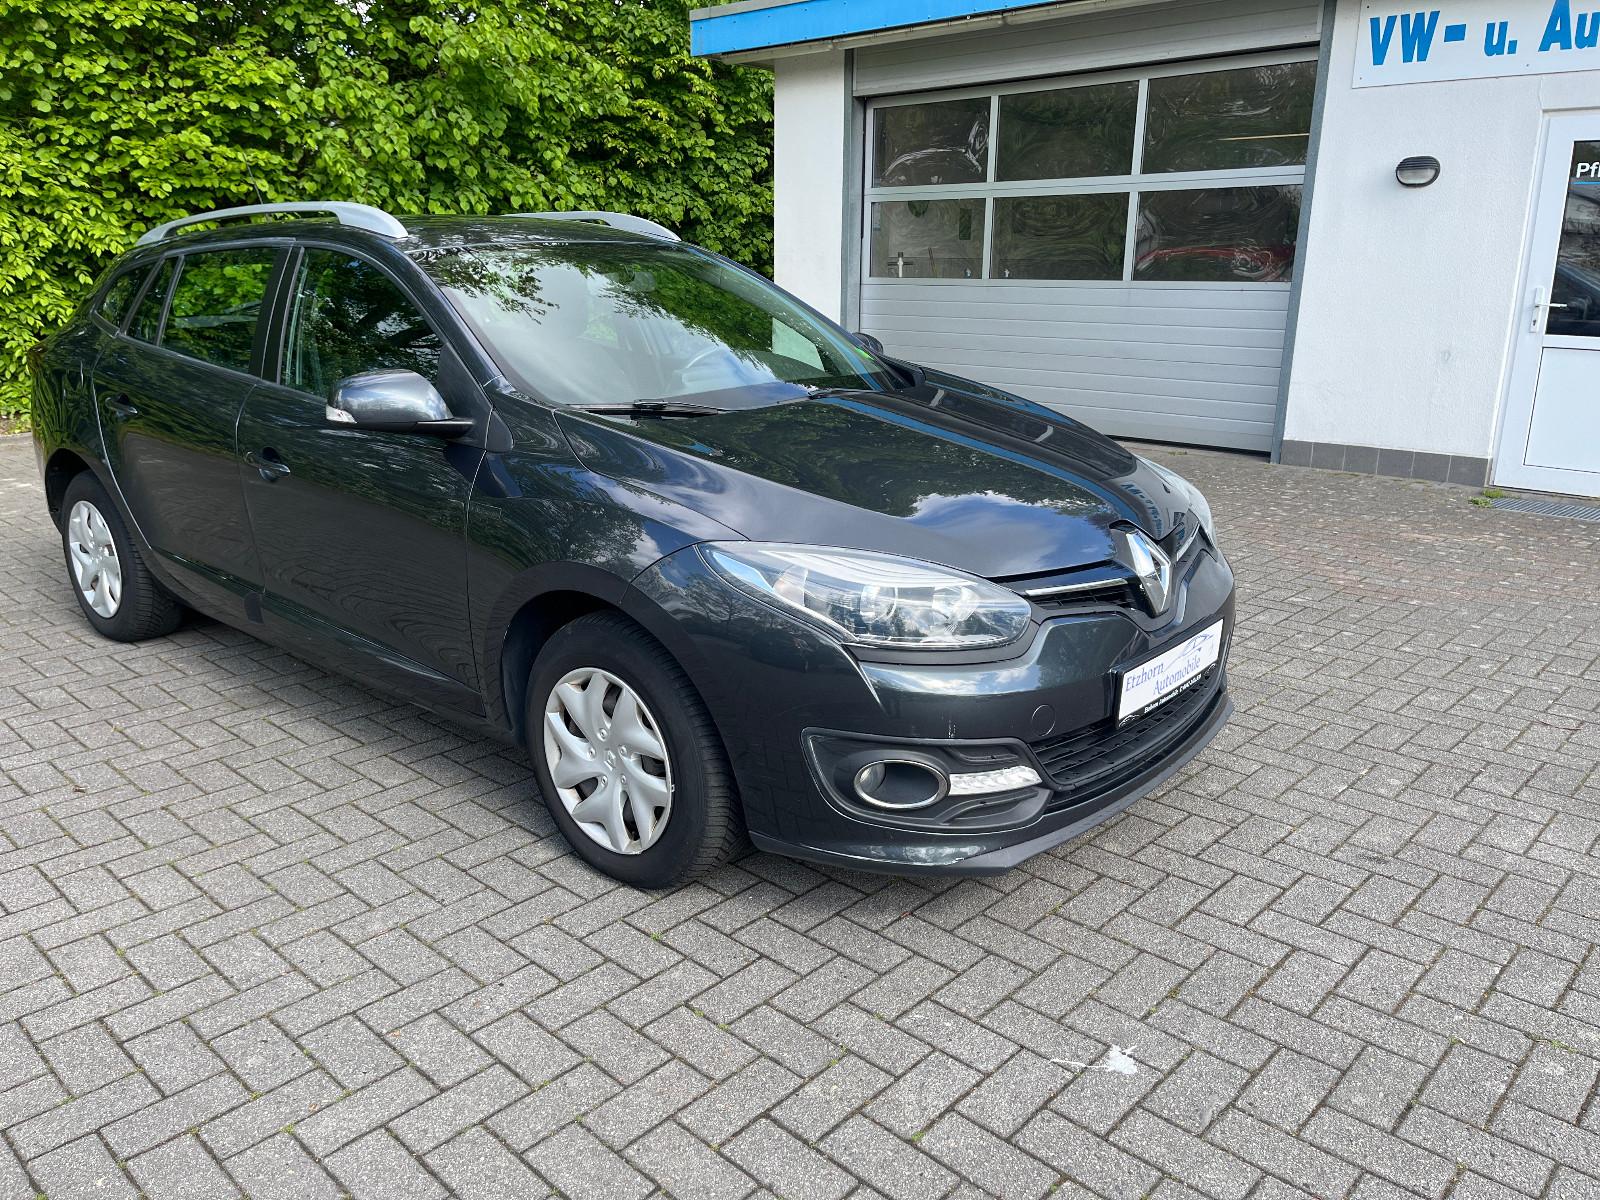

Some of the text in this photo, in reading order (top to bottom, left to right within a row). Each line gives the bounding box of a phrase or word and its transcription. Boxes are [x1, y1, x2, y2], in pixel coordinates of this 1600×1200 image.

[1369, 0, 1600, 66] VW- u. Au
[1125, 661, 1164, 692] Etzhorn
[1153, 654, 1201, 696] Automobile
